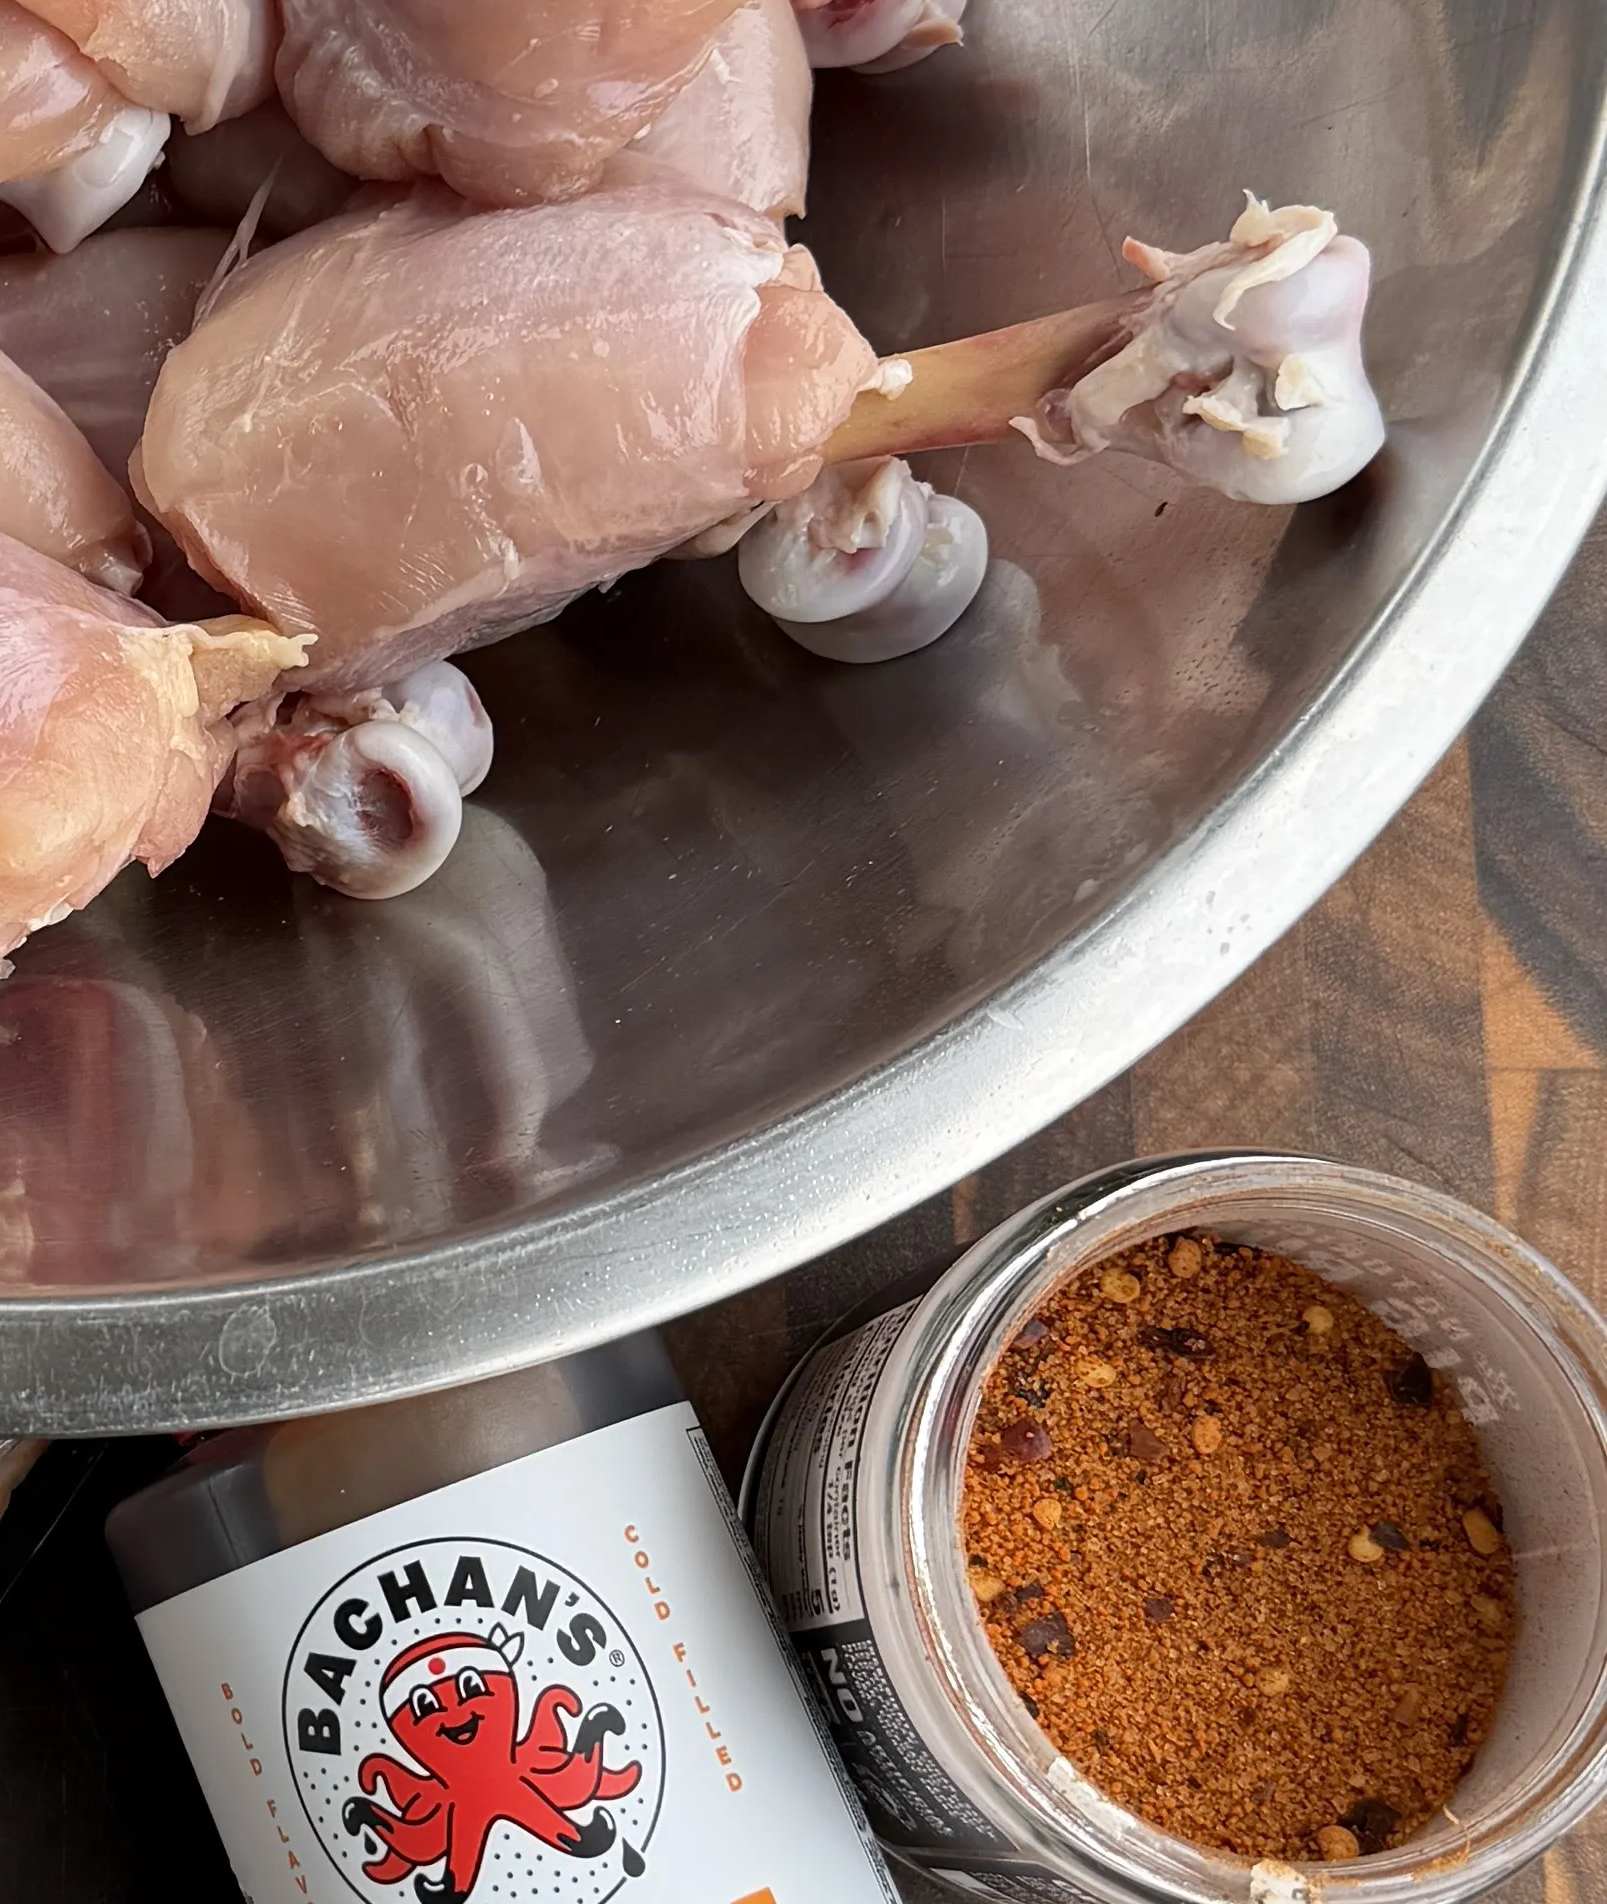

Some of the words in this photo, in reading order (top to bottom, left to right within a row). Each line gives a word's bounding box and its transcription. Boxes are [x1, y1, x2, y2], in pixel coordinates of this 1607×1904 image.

[221, 1682, 263, 1777] BOLD
[298, 1556, 607, 1757] BACHAN'S
[624, 1524, 670, 1622] COLD
[673, 1642, 743, 1793] FILLED
[821, 1647, 864, 1723] NO
